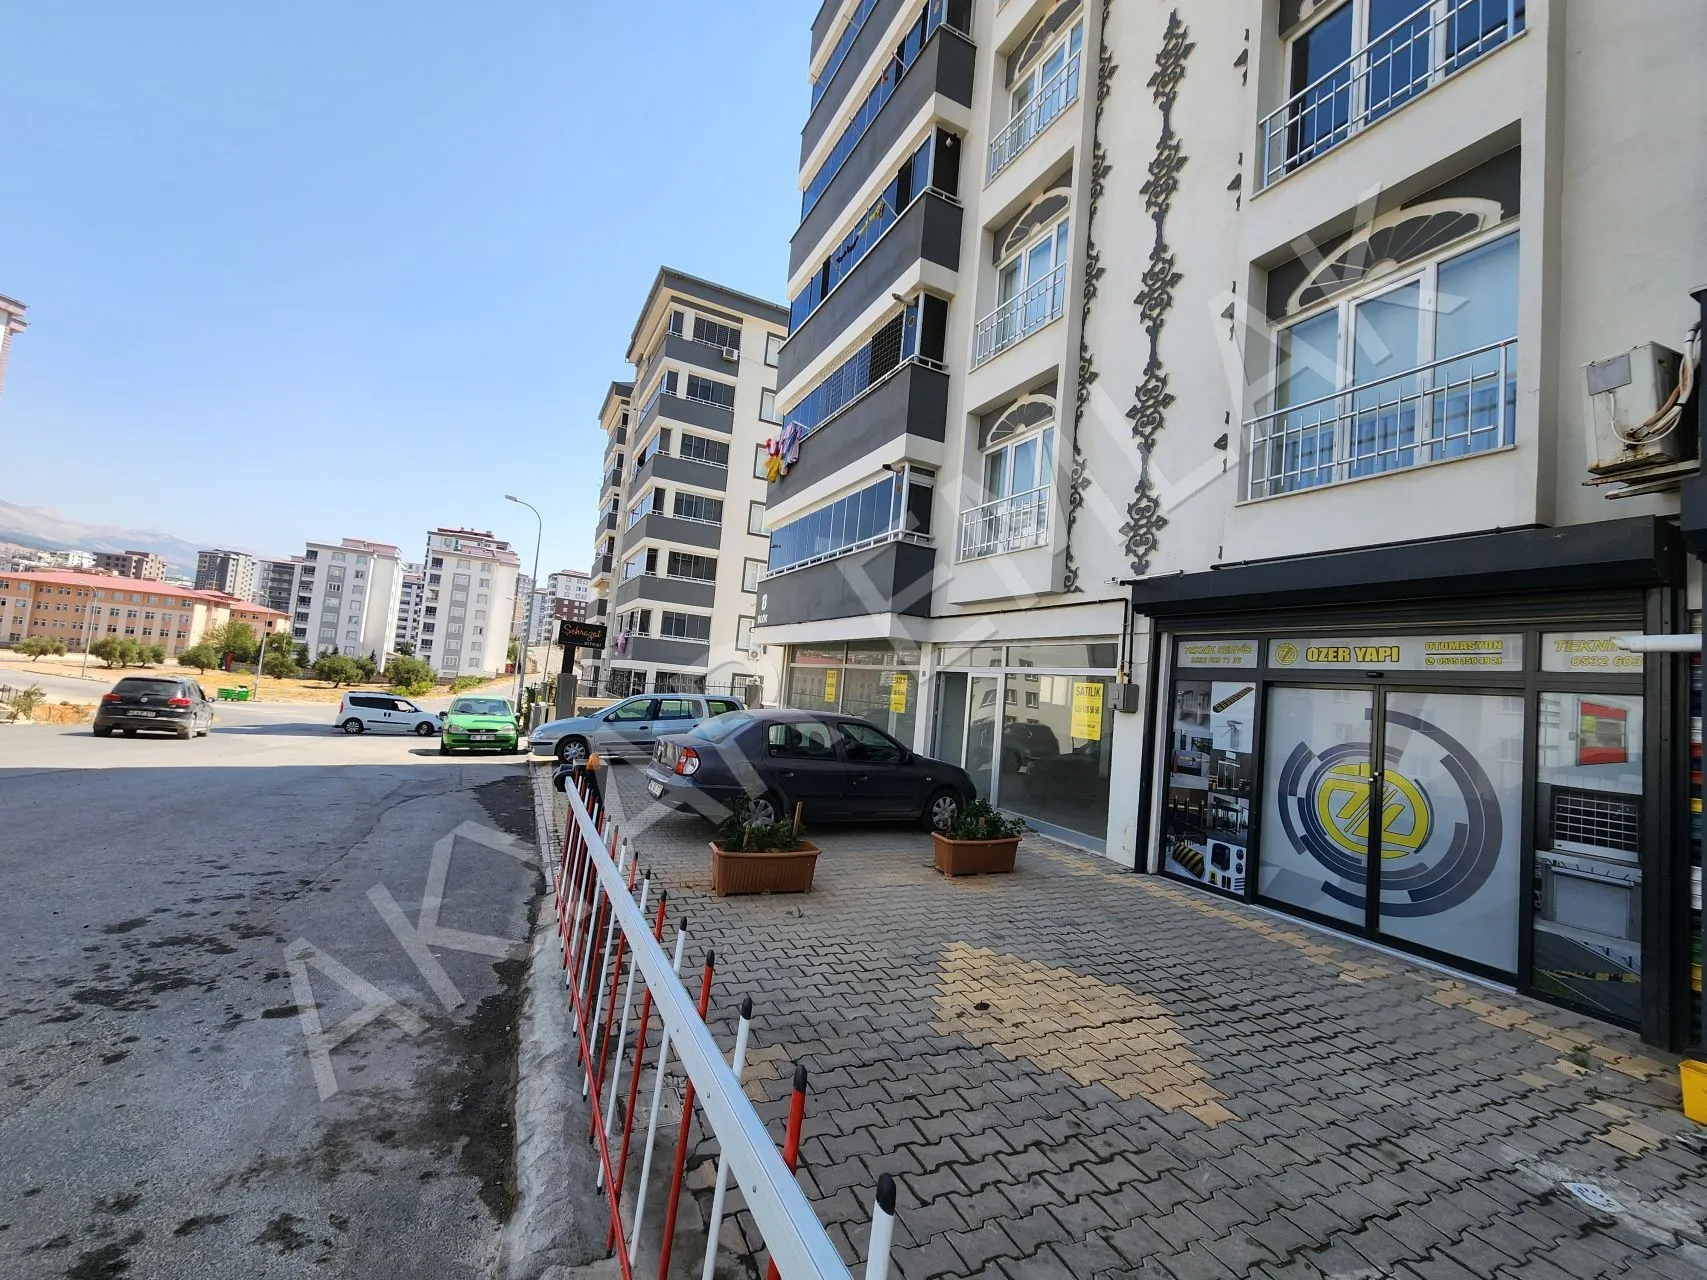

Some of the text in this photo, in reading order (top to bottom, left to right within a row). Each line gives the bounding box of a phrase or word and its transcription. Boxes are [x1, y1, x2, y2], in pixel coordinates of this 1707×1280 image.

[1425, 640, 1503, 651] OTOMASYON
[1306, 646, 1400, 662] OZER YAPI
[1571, 656, 1609, 667] 0532
[1075, 686, 1101, 698] SATILIK
